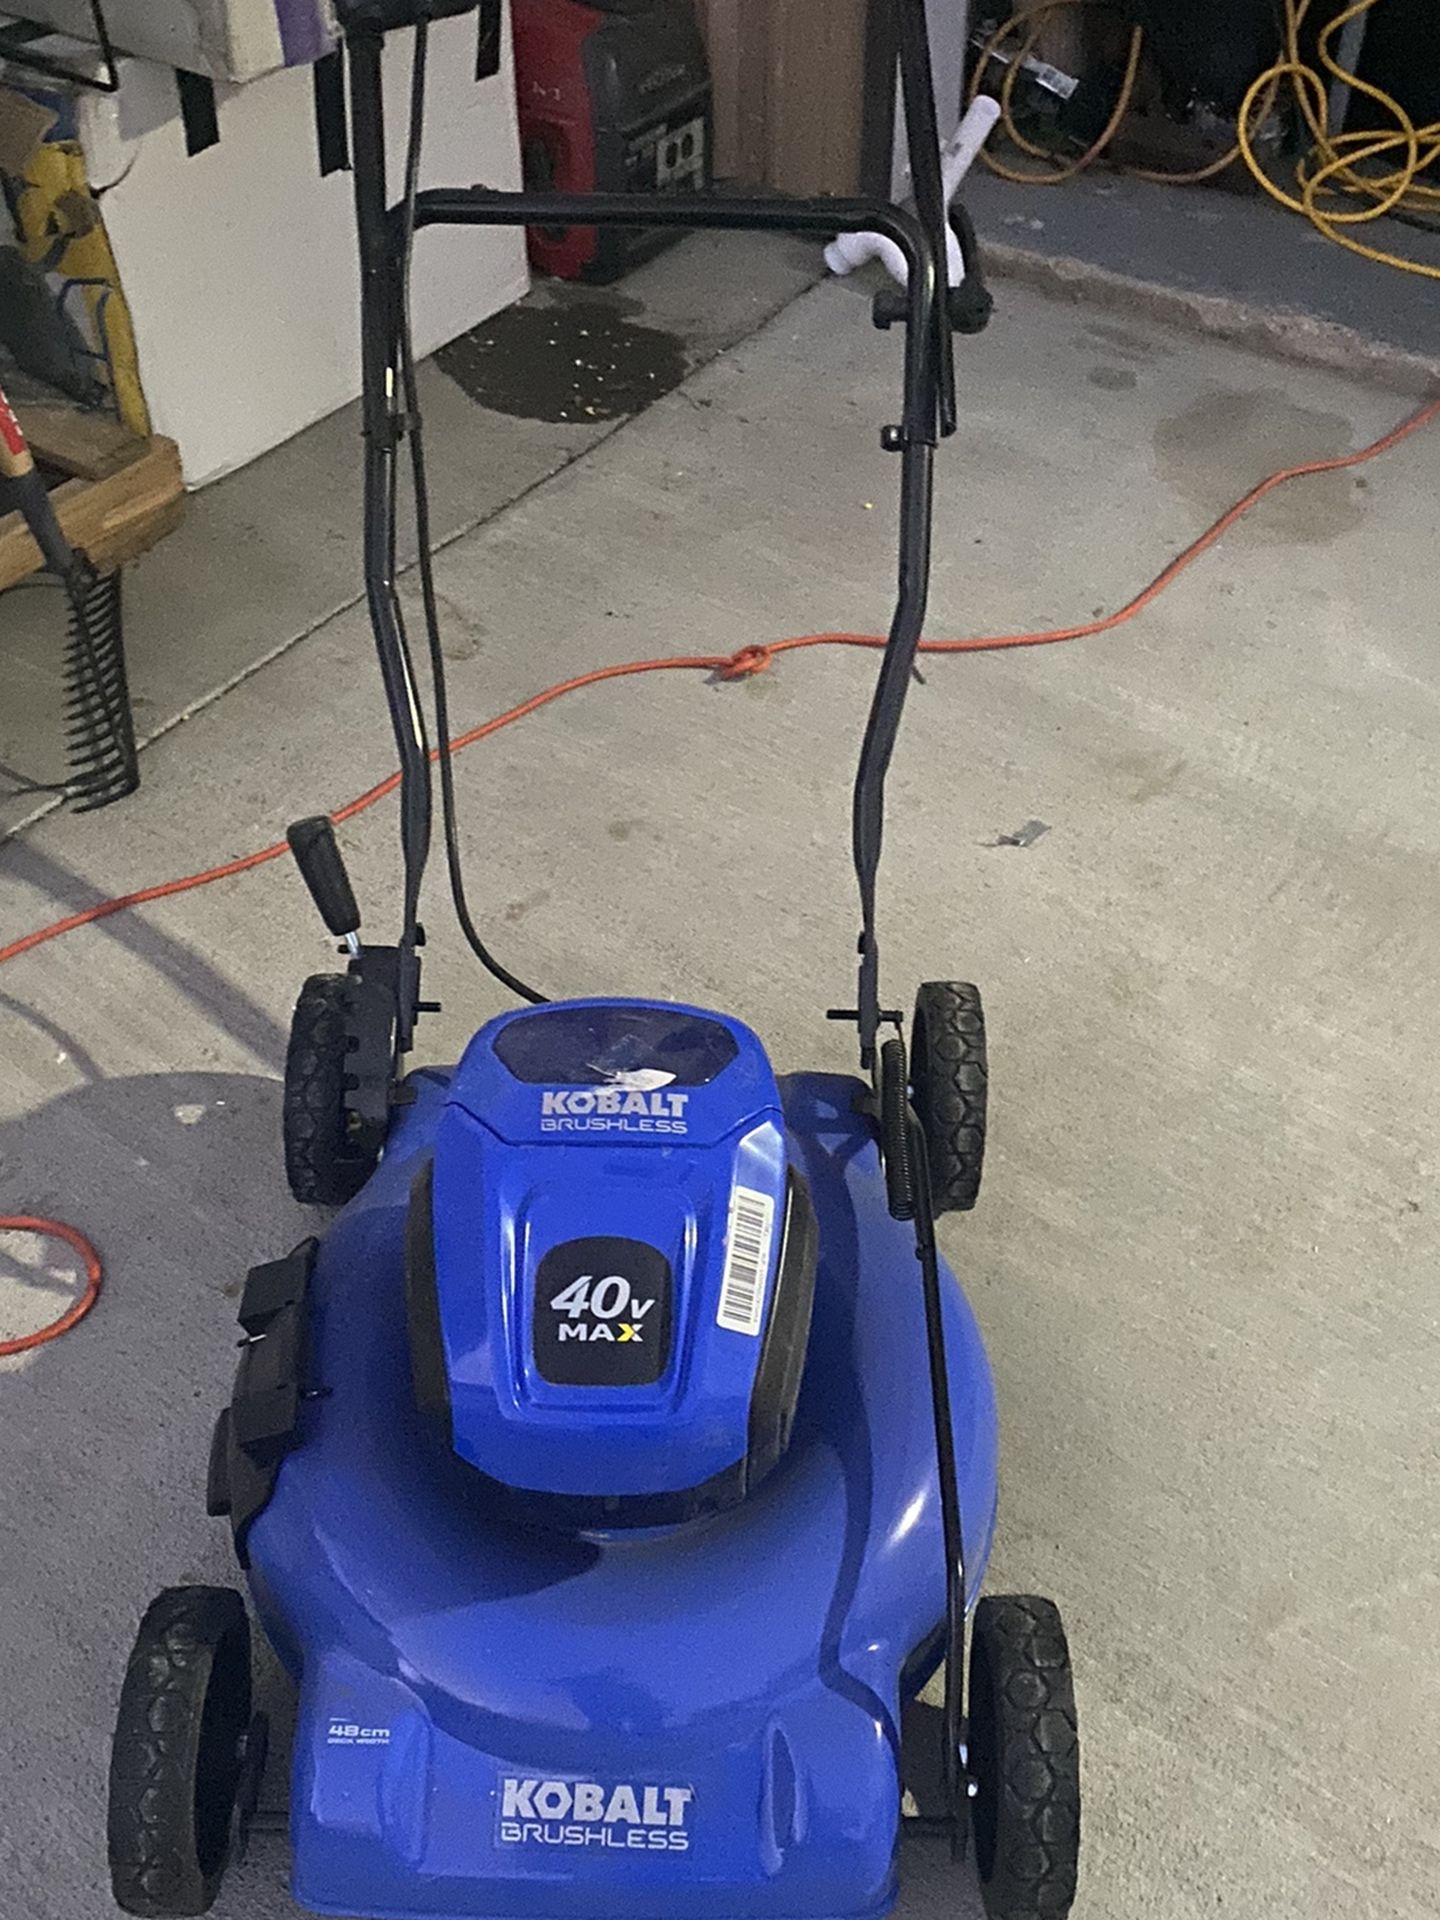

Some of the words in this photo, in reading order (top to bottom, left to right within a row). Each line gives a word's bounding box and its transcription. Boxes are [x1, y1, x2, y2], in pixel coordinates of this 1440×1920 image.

[542, 1091, 688, 1117] KOBALT
[541, 1118, 688, 1134] BRUSHLESS
[558, 1323, 644, 1342] MAX
[502, 1778, 691, 1826] KOBALT
[501, 1822, 689, 1851] BRUSHLESS
